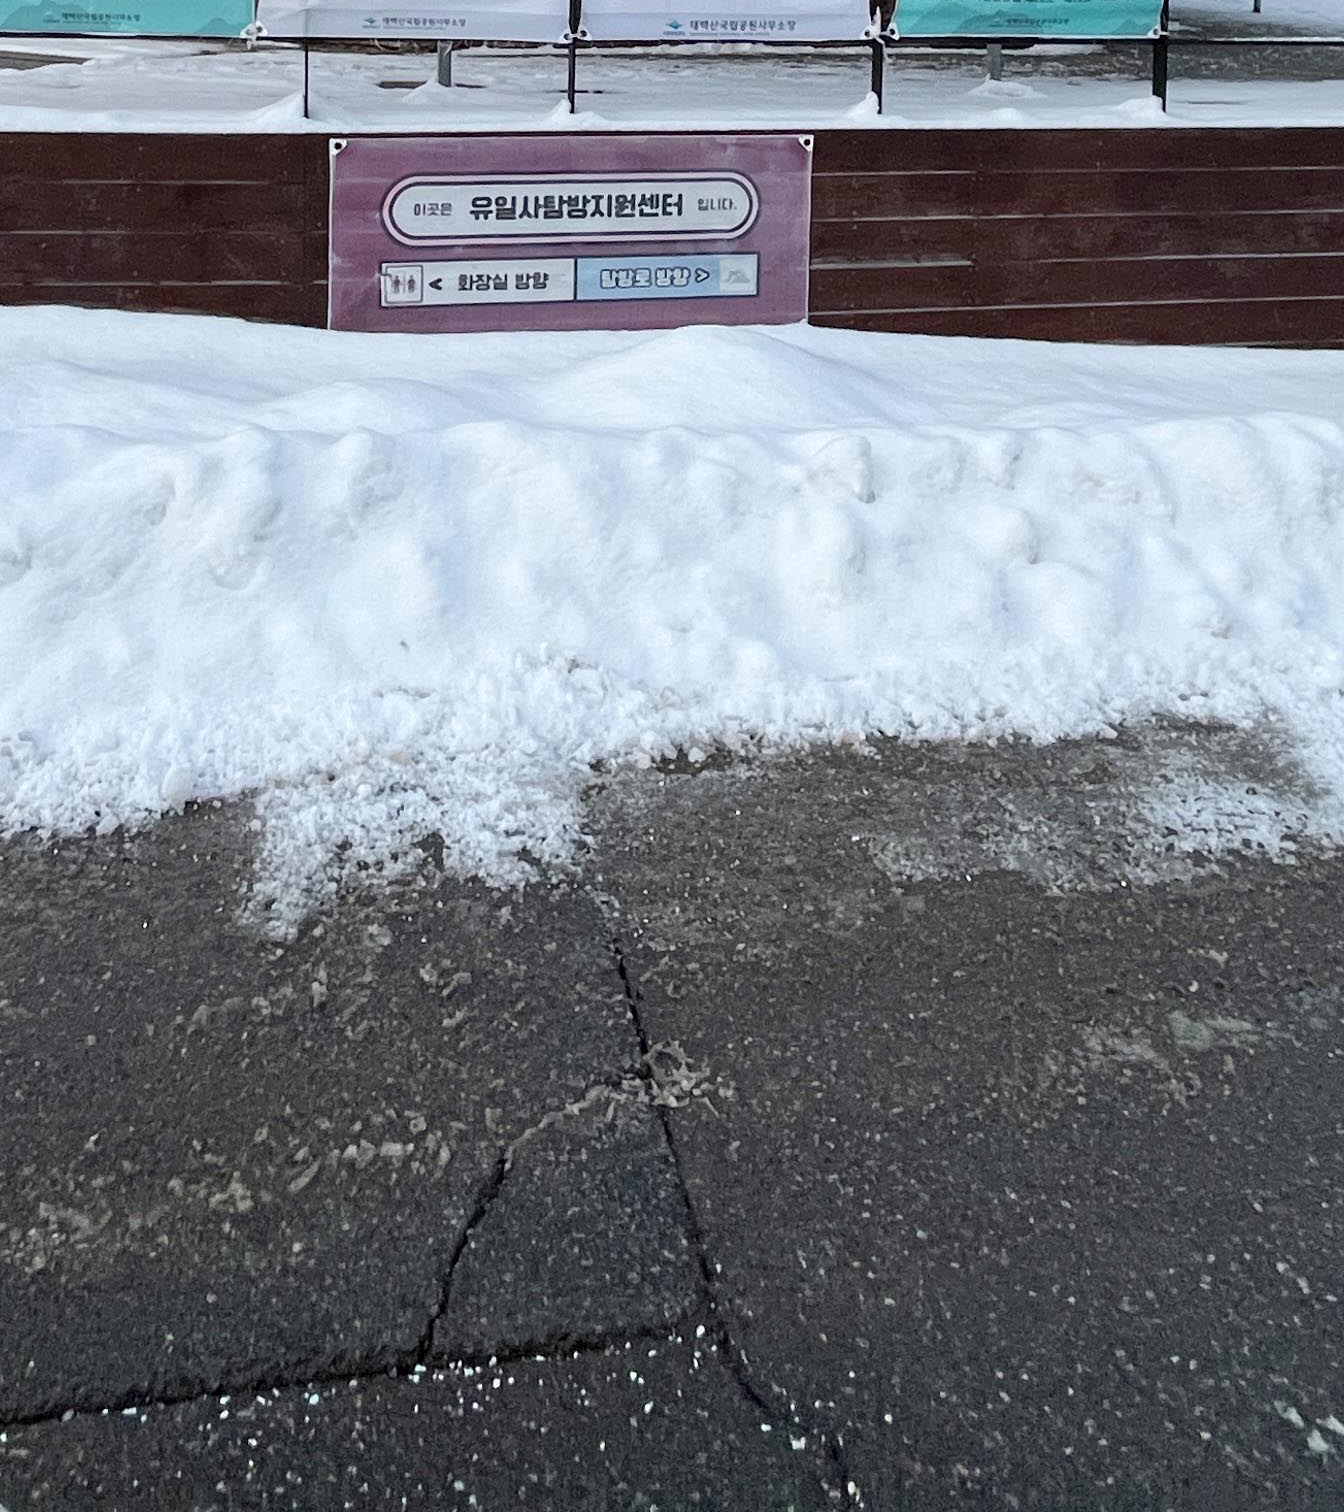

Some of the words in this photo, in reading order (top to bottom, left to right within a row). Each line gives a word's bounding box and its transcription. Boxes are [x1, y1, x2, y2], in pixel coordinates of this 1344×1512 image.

[413, 202, 452, 217] 이곳은
[469, 193, 683, 221] 유일사탐방지원센터
[697, 198, 737, 212] 입니다.
[457, 272, 508, 291] 화장실
[515, 272, 550, 290] 방향
